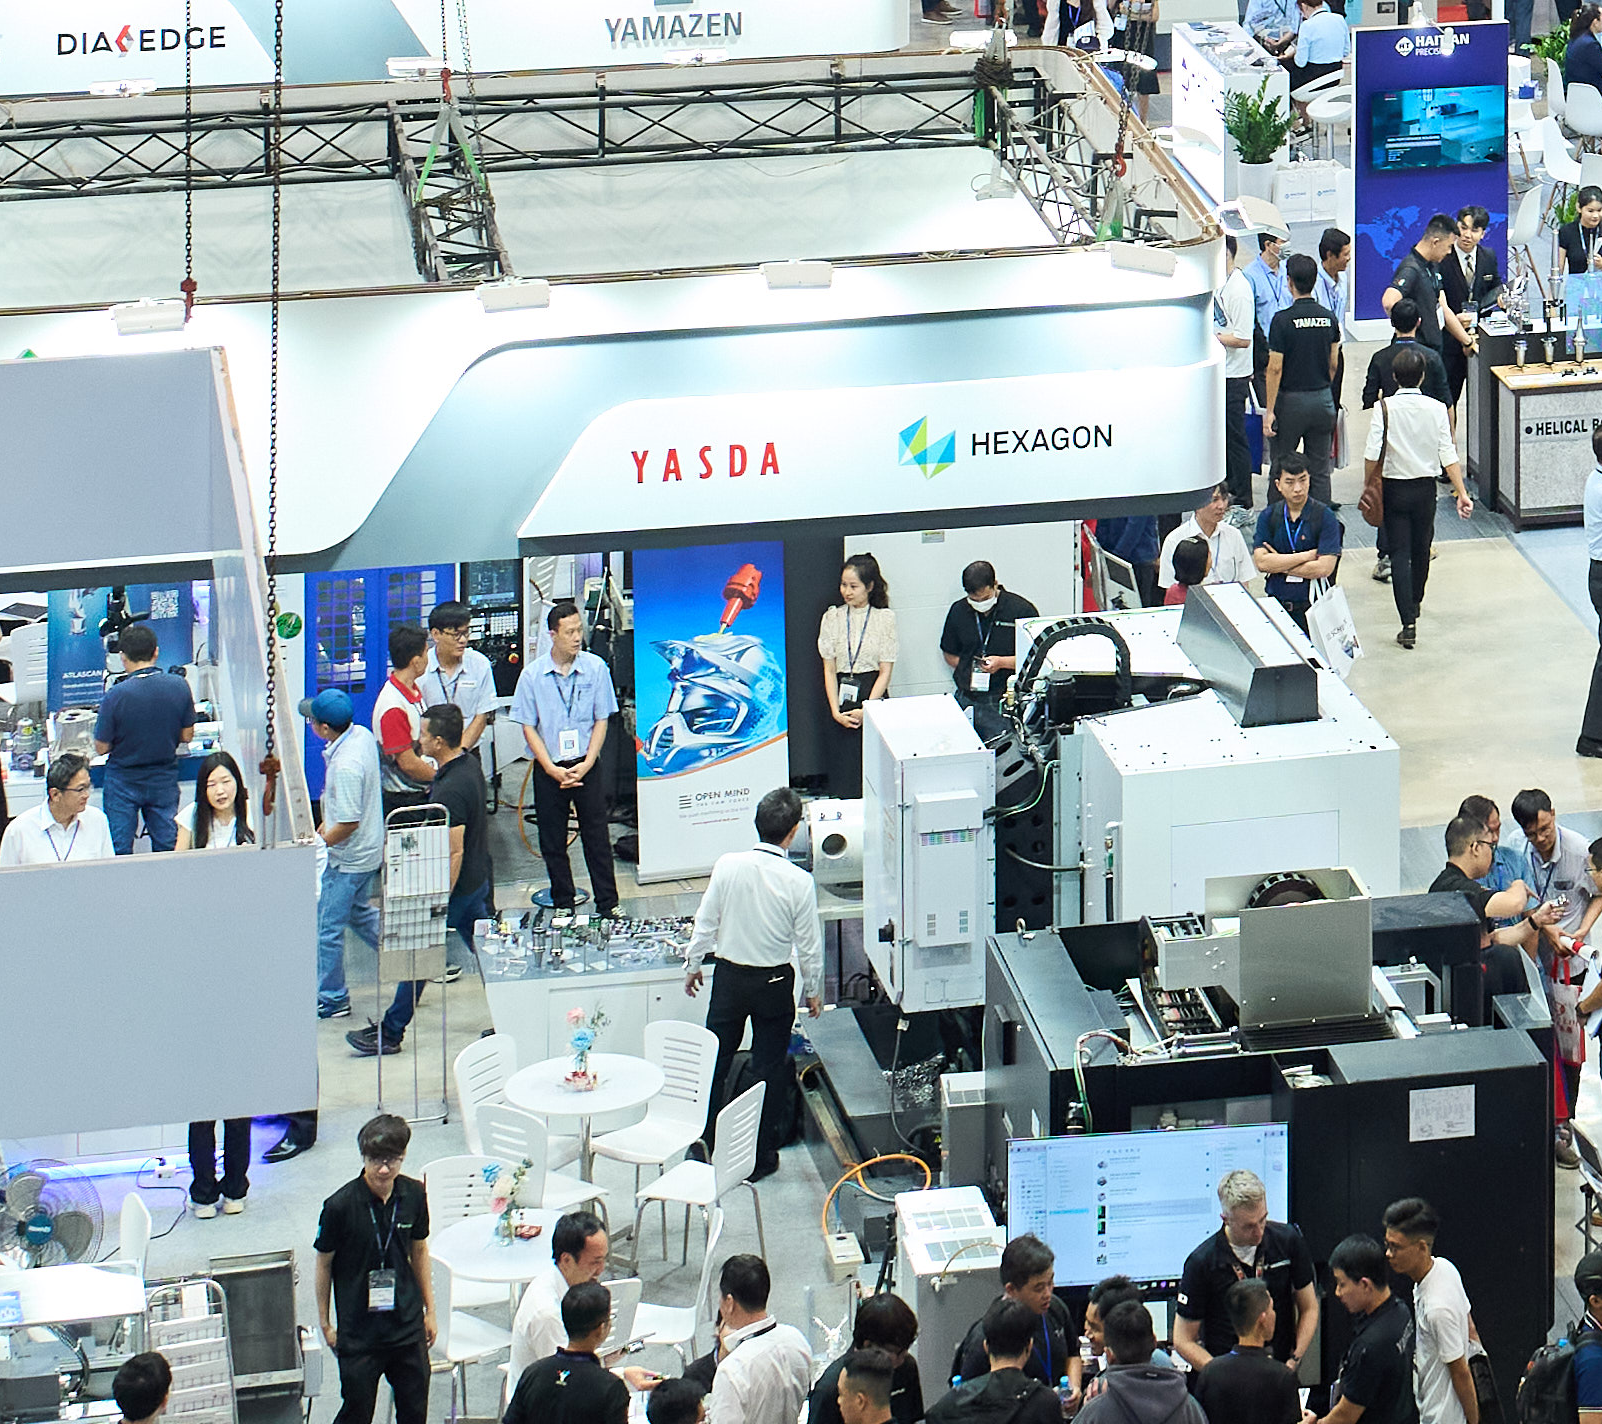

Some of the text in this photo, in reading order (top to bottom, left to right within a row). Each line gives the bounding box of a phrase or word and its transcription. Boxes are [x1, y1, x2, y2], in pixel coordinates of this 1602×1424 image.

[604, 10, 743, 44] YAMAZEN
[1292, 317, 1332, 330] YAMAZEN
[971, 423, 1114, 457] HEXAGON
[1535, 417, 1589, 438] HELICAL
[630, 441, 781, 484] YASDA
